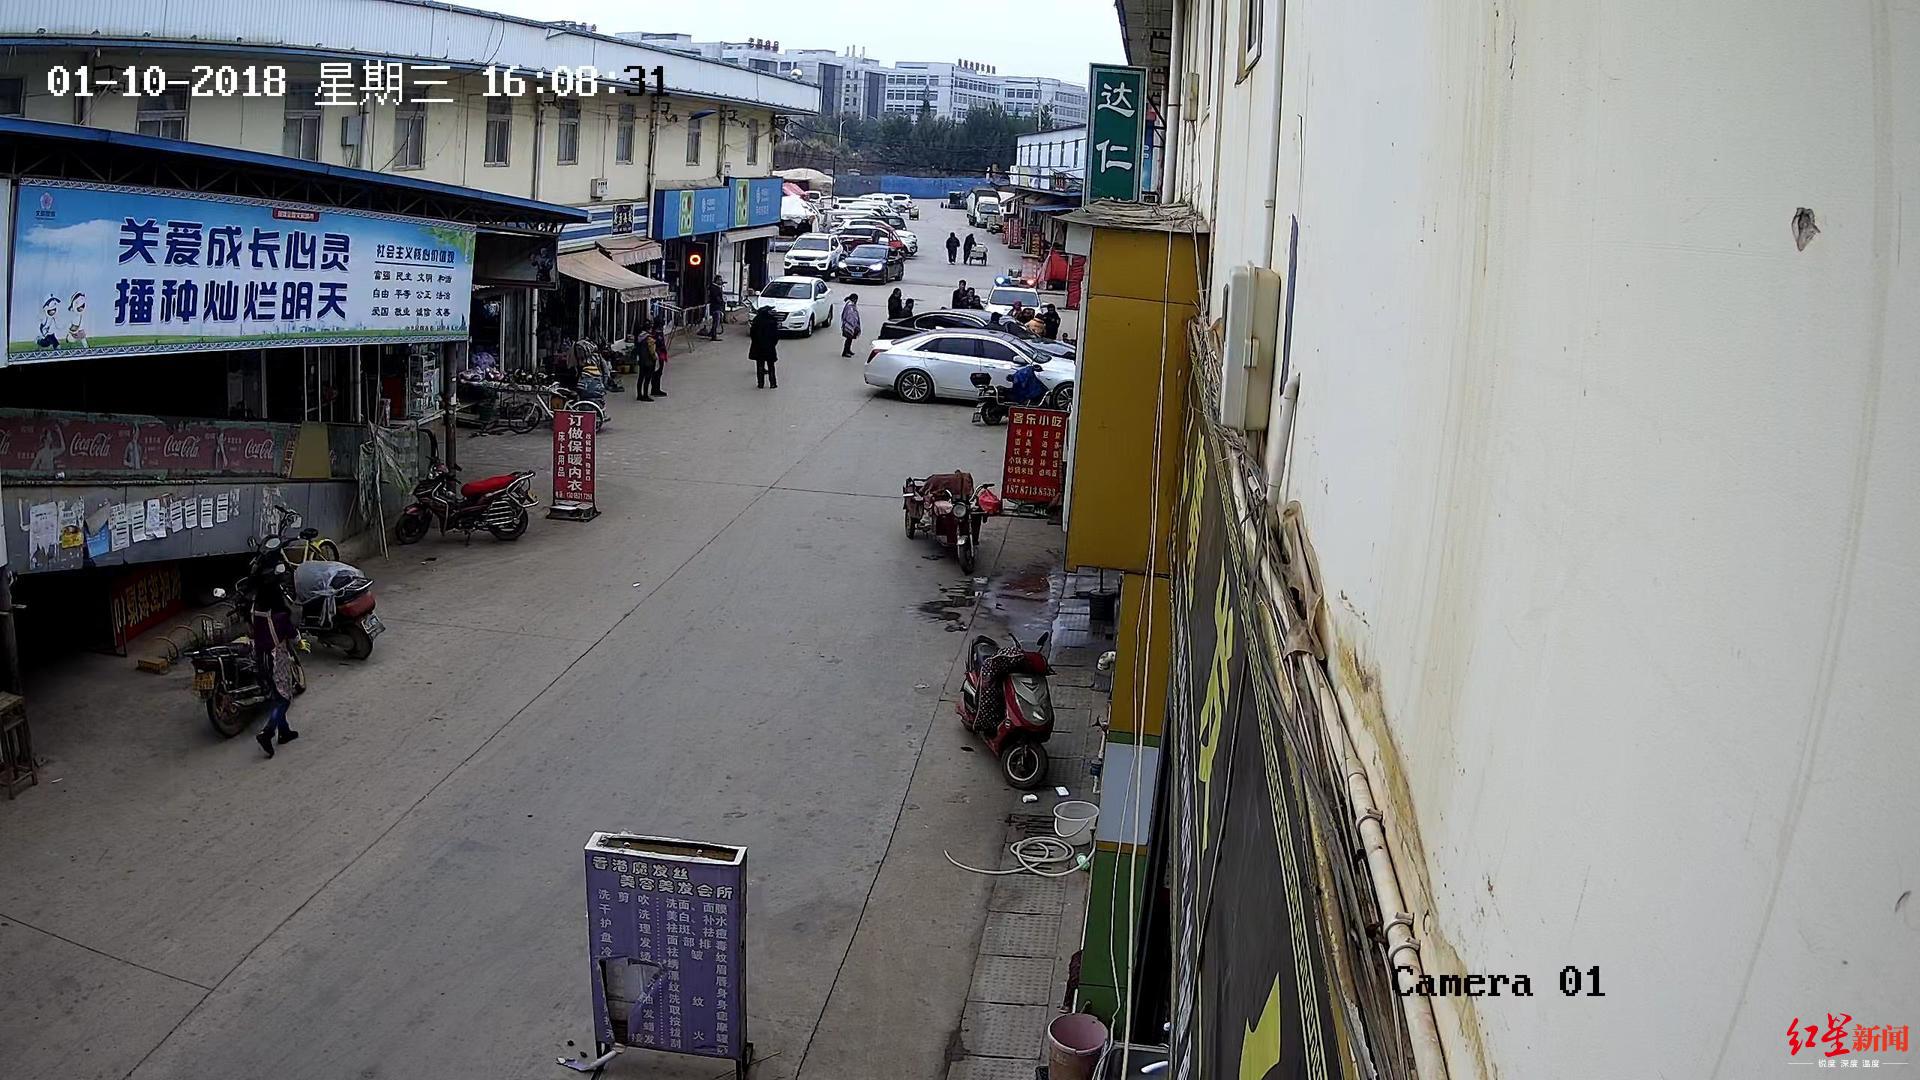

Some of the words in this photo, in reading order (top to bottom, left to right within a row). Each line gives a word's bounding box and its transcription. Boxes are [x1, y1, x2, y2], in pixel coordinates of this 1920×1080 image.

[118, 216, 350, 272] 关爱成长心灵
[376, 243, 455, 264] 社会主义核心价值观
[417, 272, 433, 283] 文明
[114, 278, 349, 325] 播种灿烂明天
[372, 287, 389, 299] 自由
[416, 290, 432, 300] 公正
[567, 414, 584, 491] 订做保暖内衣
[619, 874, 734, 900] 美容美发会所
